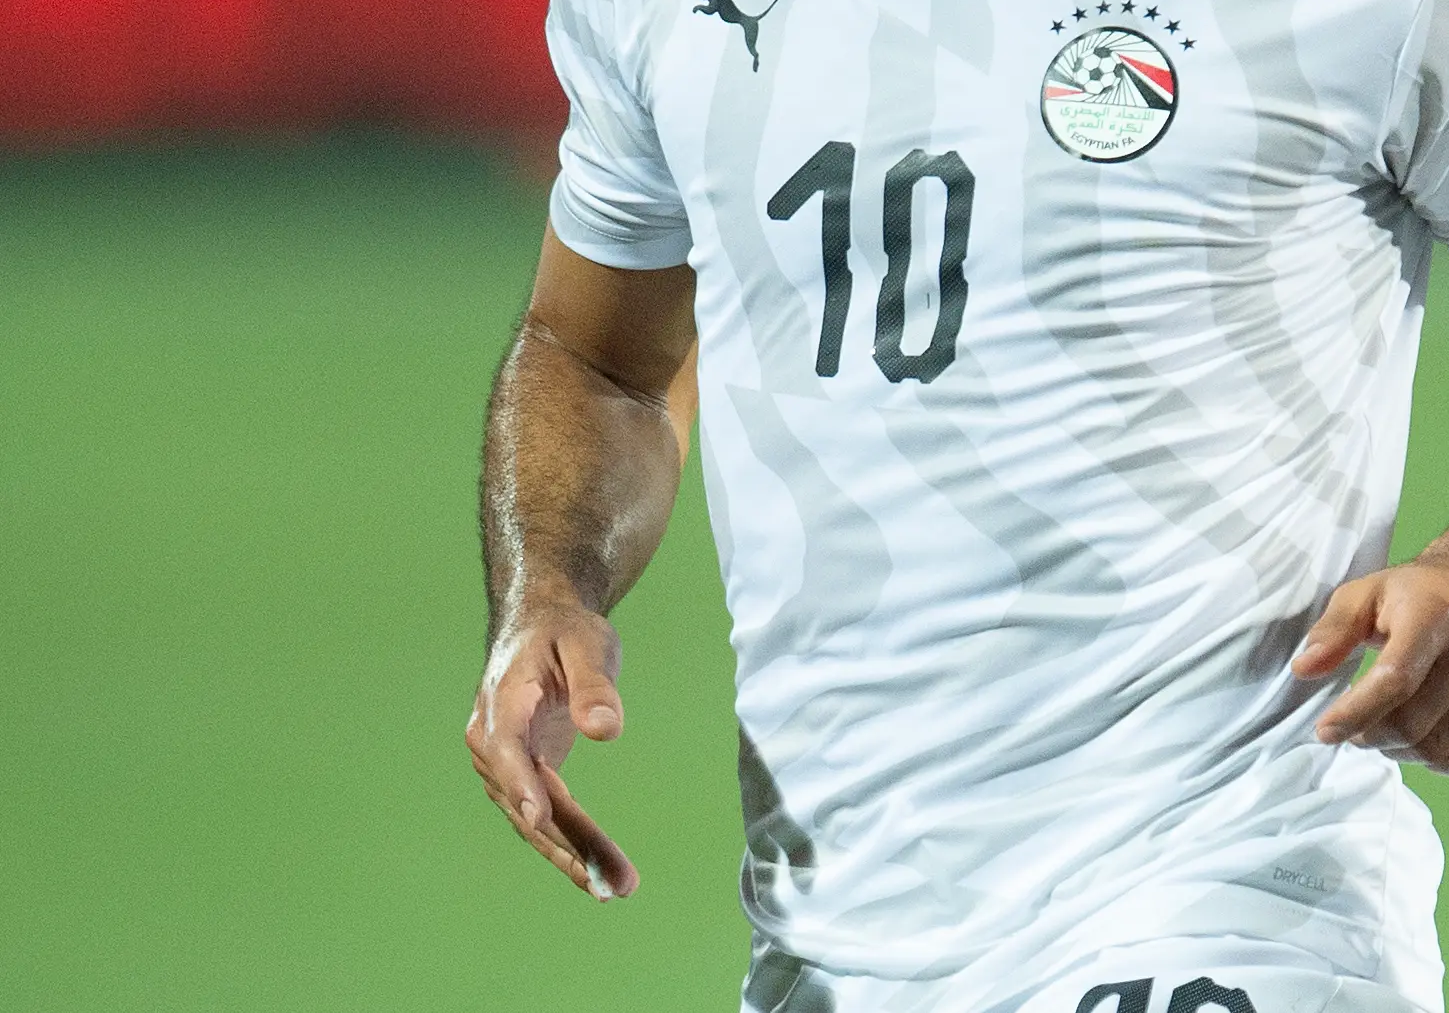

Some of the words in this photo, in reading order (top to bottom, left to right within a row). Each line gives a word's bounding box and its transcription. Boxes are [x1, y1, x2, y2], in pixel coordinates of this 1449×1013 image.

[1070, 131, 1120, 150] EGYPTIAN
[1122, 136, 1136, 149] FA
[767, 140, 976, 385] 10
